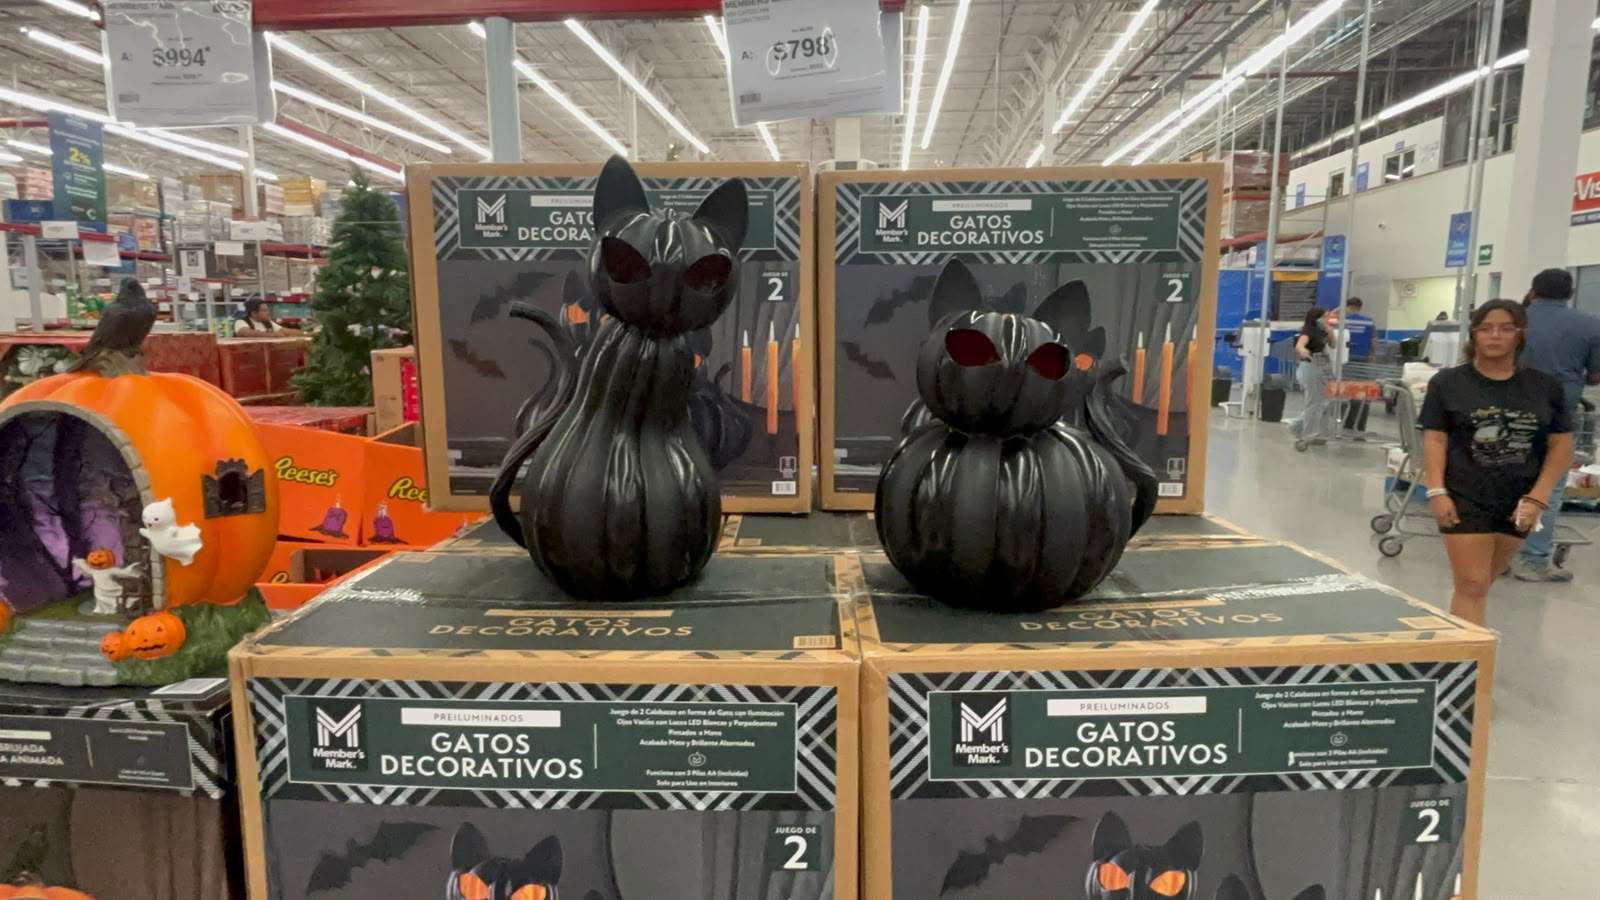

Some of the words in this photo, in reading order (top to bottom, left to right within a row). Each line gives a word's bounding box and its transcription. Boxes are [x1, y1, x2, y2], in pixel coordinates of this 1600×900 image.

[741, 51, 753, 60] A:
[474, 223, 508, 232] Member's
[950, 215, 1012, 229] GATOS
[518, 227, 597, 241] DECORA
[875, 228, 909, 237] Member's
[917, 230, 1044, 245] DECORATIVOS
[767, 278, 784, 301] 2
[1166, 278, 1183, 302] 2
[275, 457, 337, 486] Reese's
[1078, 608, 1203, 621] GATOS
[509, 617, 632, 628] GATOS
[1020, 612, 1285, 631] DECORATIVOS
[429, 624, 694, 637] DECORATIVOS
[608, 708, 630, 716] Juego
[645, 708, 678, 716] Calabazas
[1079, 701, 1170, 711] PREILUMINADOS
[433, 712, 524, 722] PREILUMINADOS
[1077, 721, 1176, 743] GATOS
[431, 732, 530, 755] GATOS
[955, 743, 1009, 754] Member's
[313, 747, 365, 759] Member's
[1025, 743, 1228, 768] DECORATIVOS
[10, 754, 65, 766] ANIMADA
[381, 755, 584, 779] DECORATIVOS
[1410, 800, 1437, 808] JUEGO
[1438, 799, 1450, 807] DE
[1416, 808, 1440, 842] 2
[783, 835, 809, 869] 2
